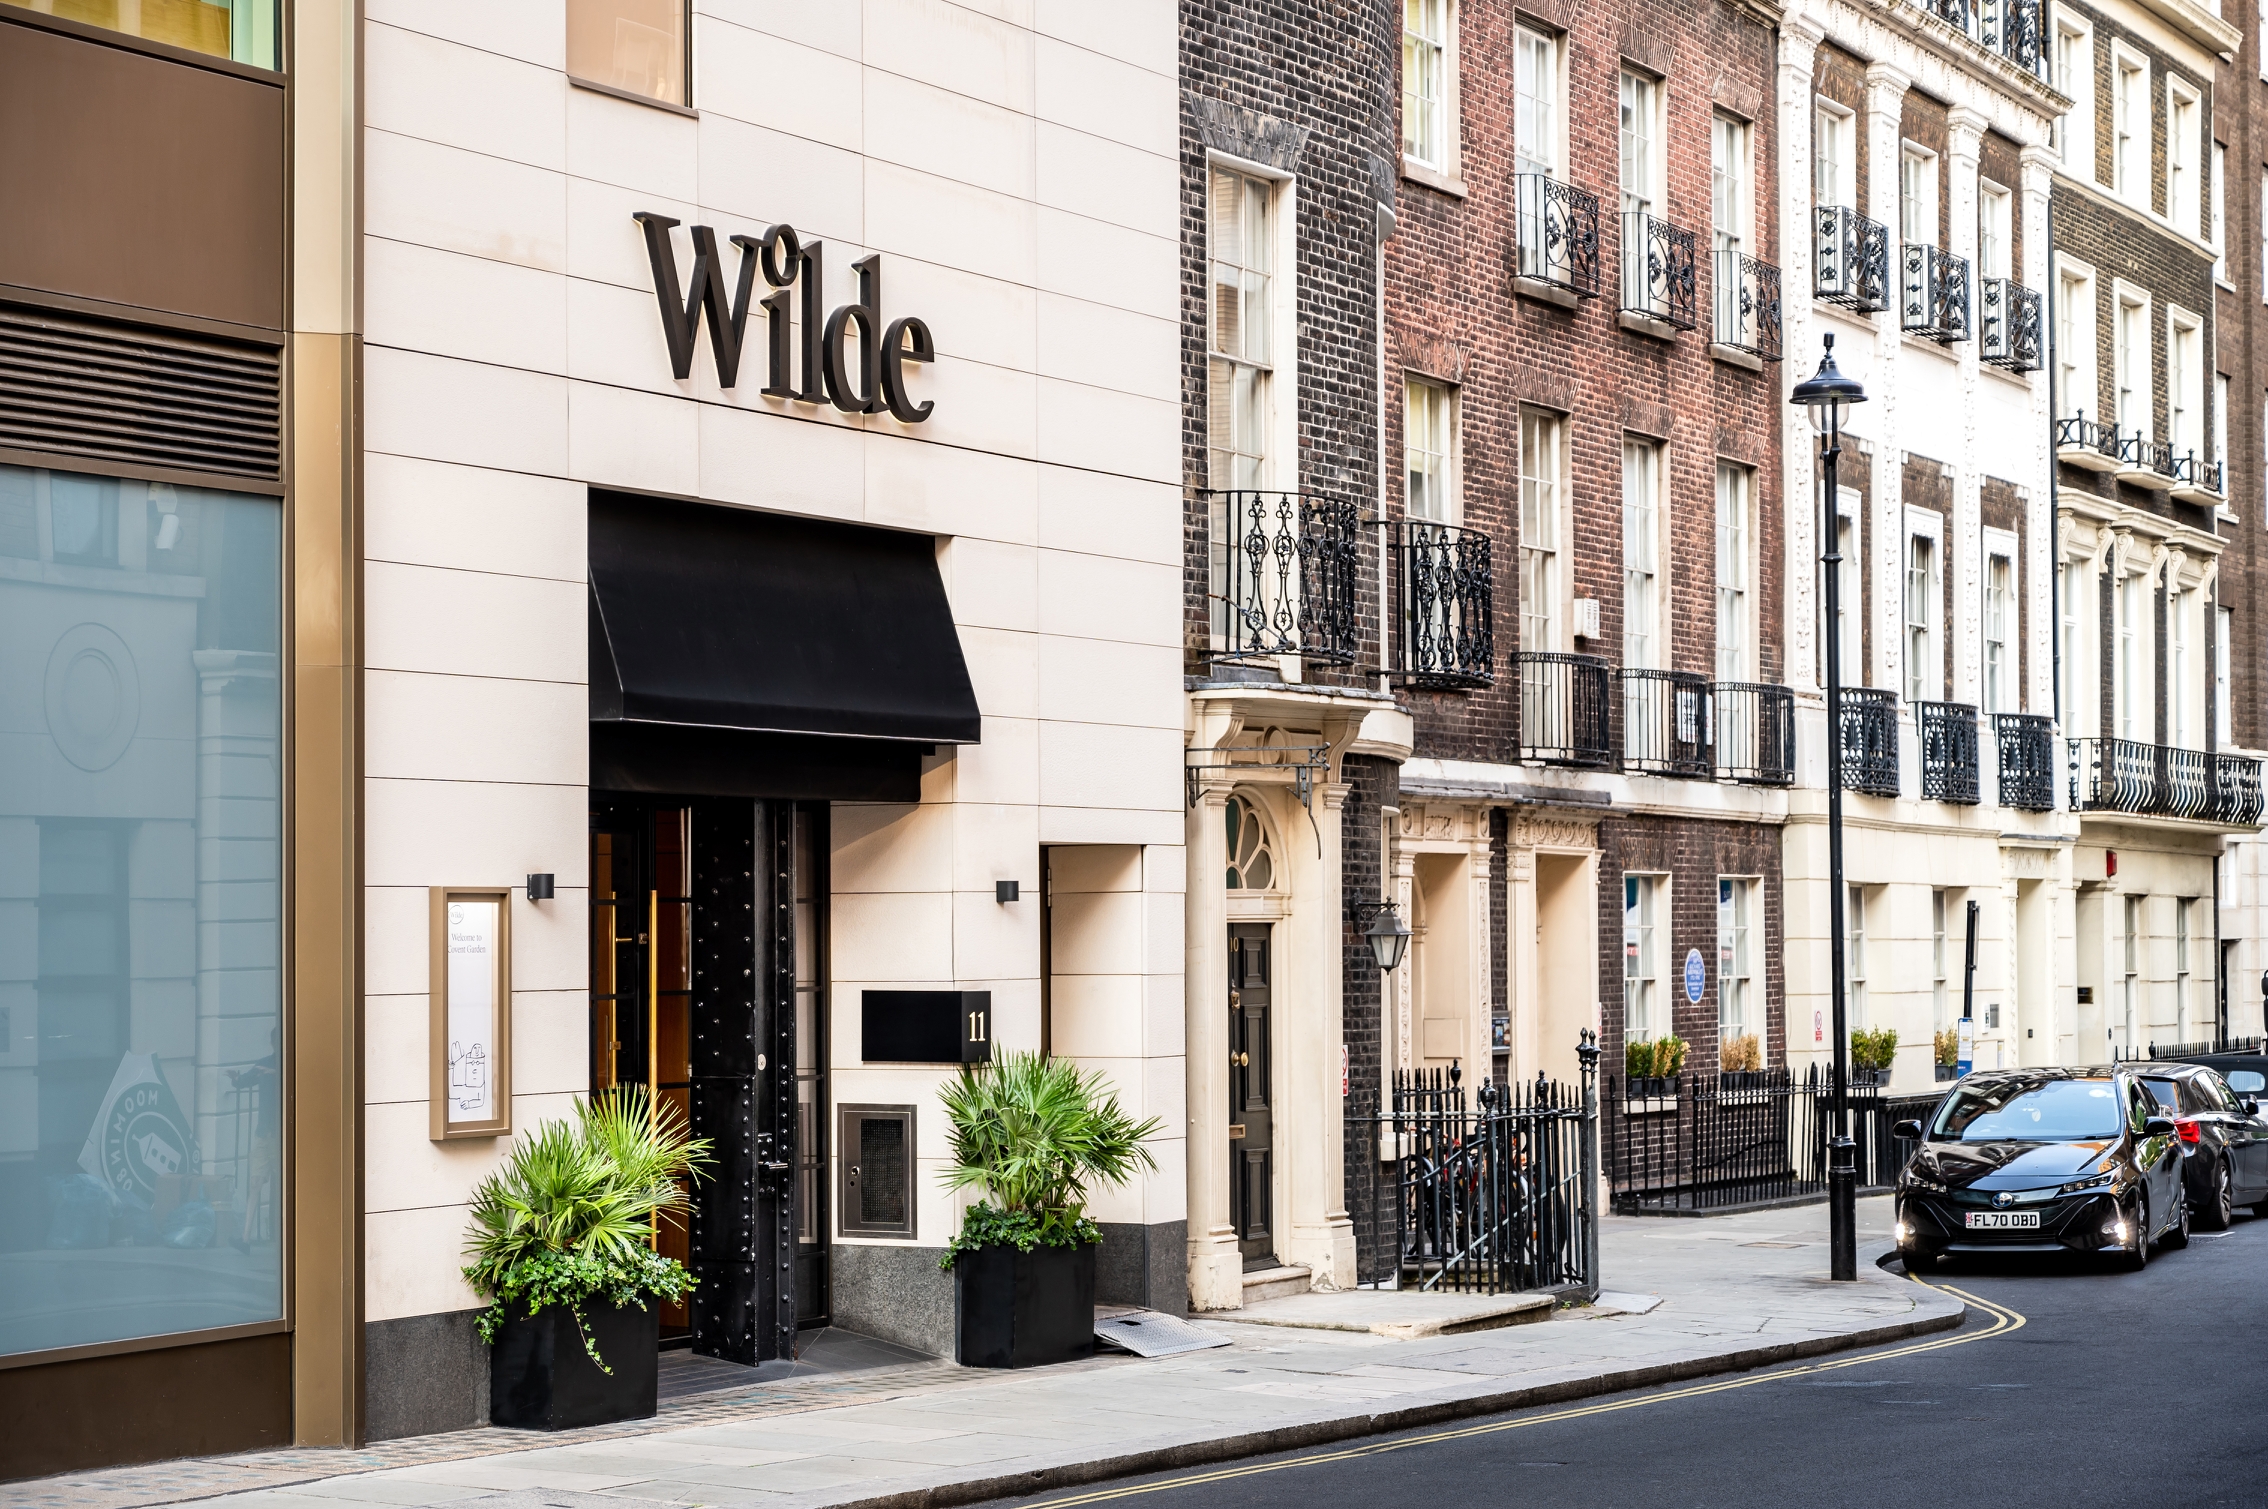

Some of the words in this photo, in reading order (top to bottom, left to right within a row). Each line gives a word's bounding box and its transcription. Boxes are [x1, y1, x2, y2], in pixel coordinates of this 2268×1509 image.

[632, 210, 935, 424] Wilde
[451, 933, 475, 942] Welcome
[476, 934, 482, 942] to
[1230, 937, 1239, 952] 10
[448, 945, 466, 954] Covent
[466, 944, 486, 954] Garden
[969, 1011, 986, 1042] 11
[1974, 1214, 2008, 1227] FL70
[2011, 1214, 2037, 1227] OBD
